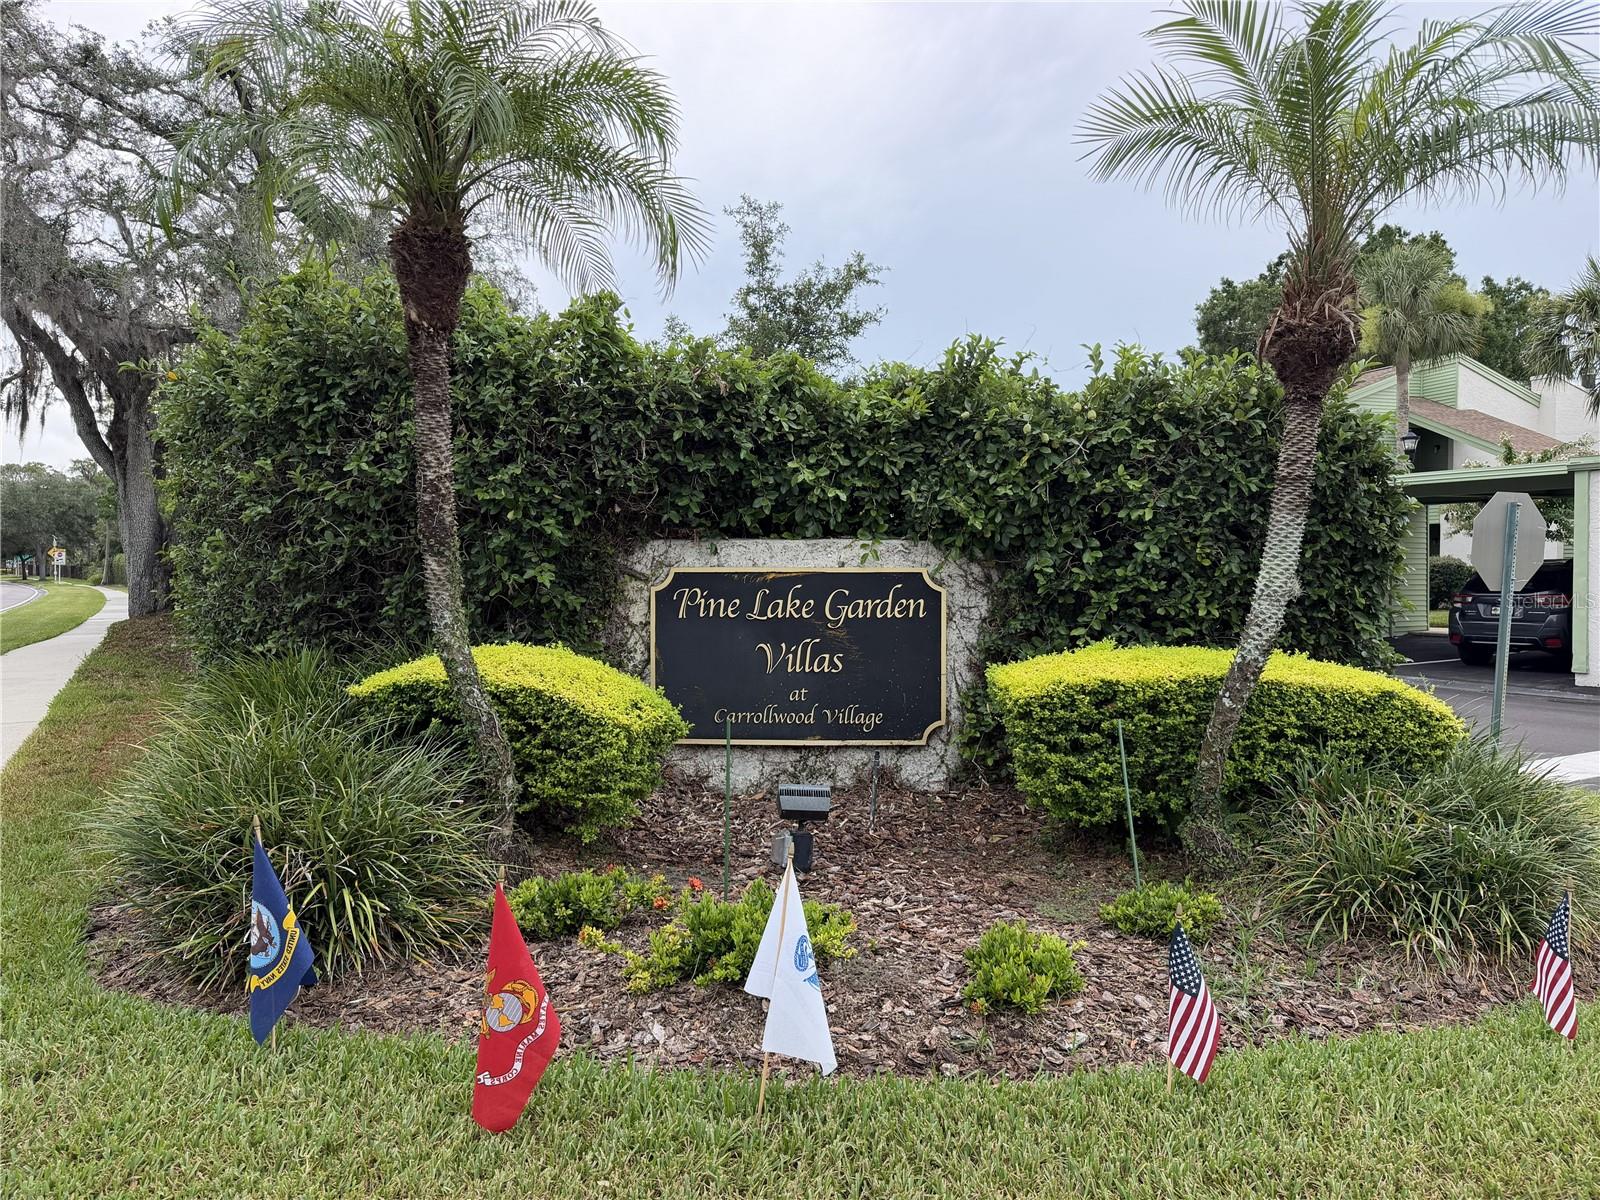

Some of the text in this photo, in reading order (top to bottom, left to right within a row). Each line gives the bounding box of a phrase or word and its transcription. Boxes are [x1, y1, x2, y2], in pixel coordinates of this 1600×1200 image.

[673, 584, 927, 629] Pine Lake Garden
[755, 638, 844, 674] Villas
[789, 687, 808, 701] at
[714, 703, 883, 733] Carrollwood Village
